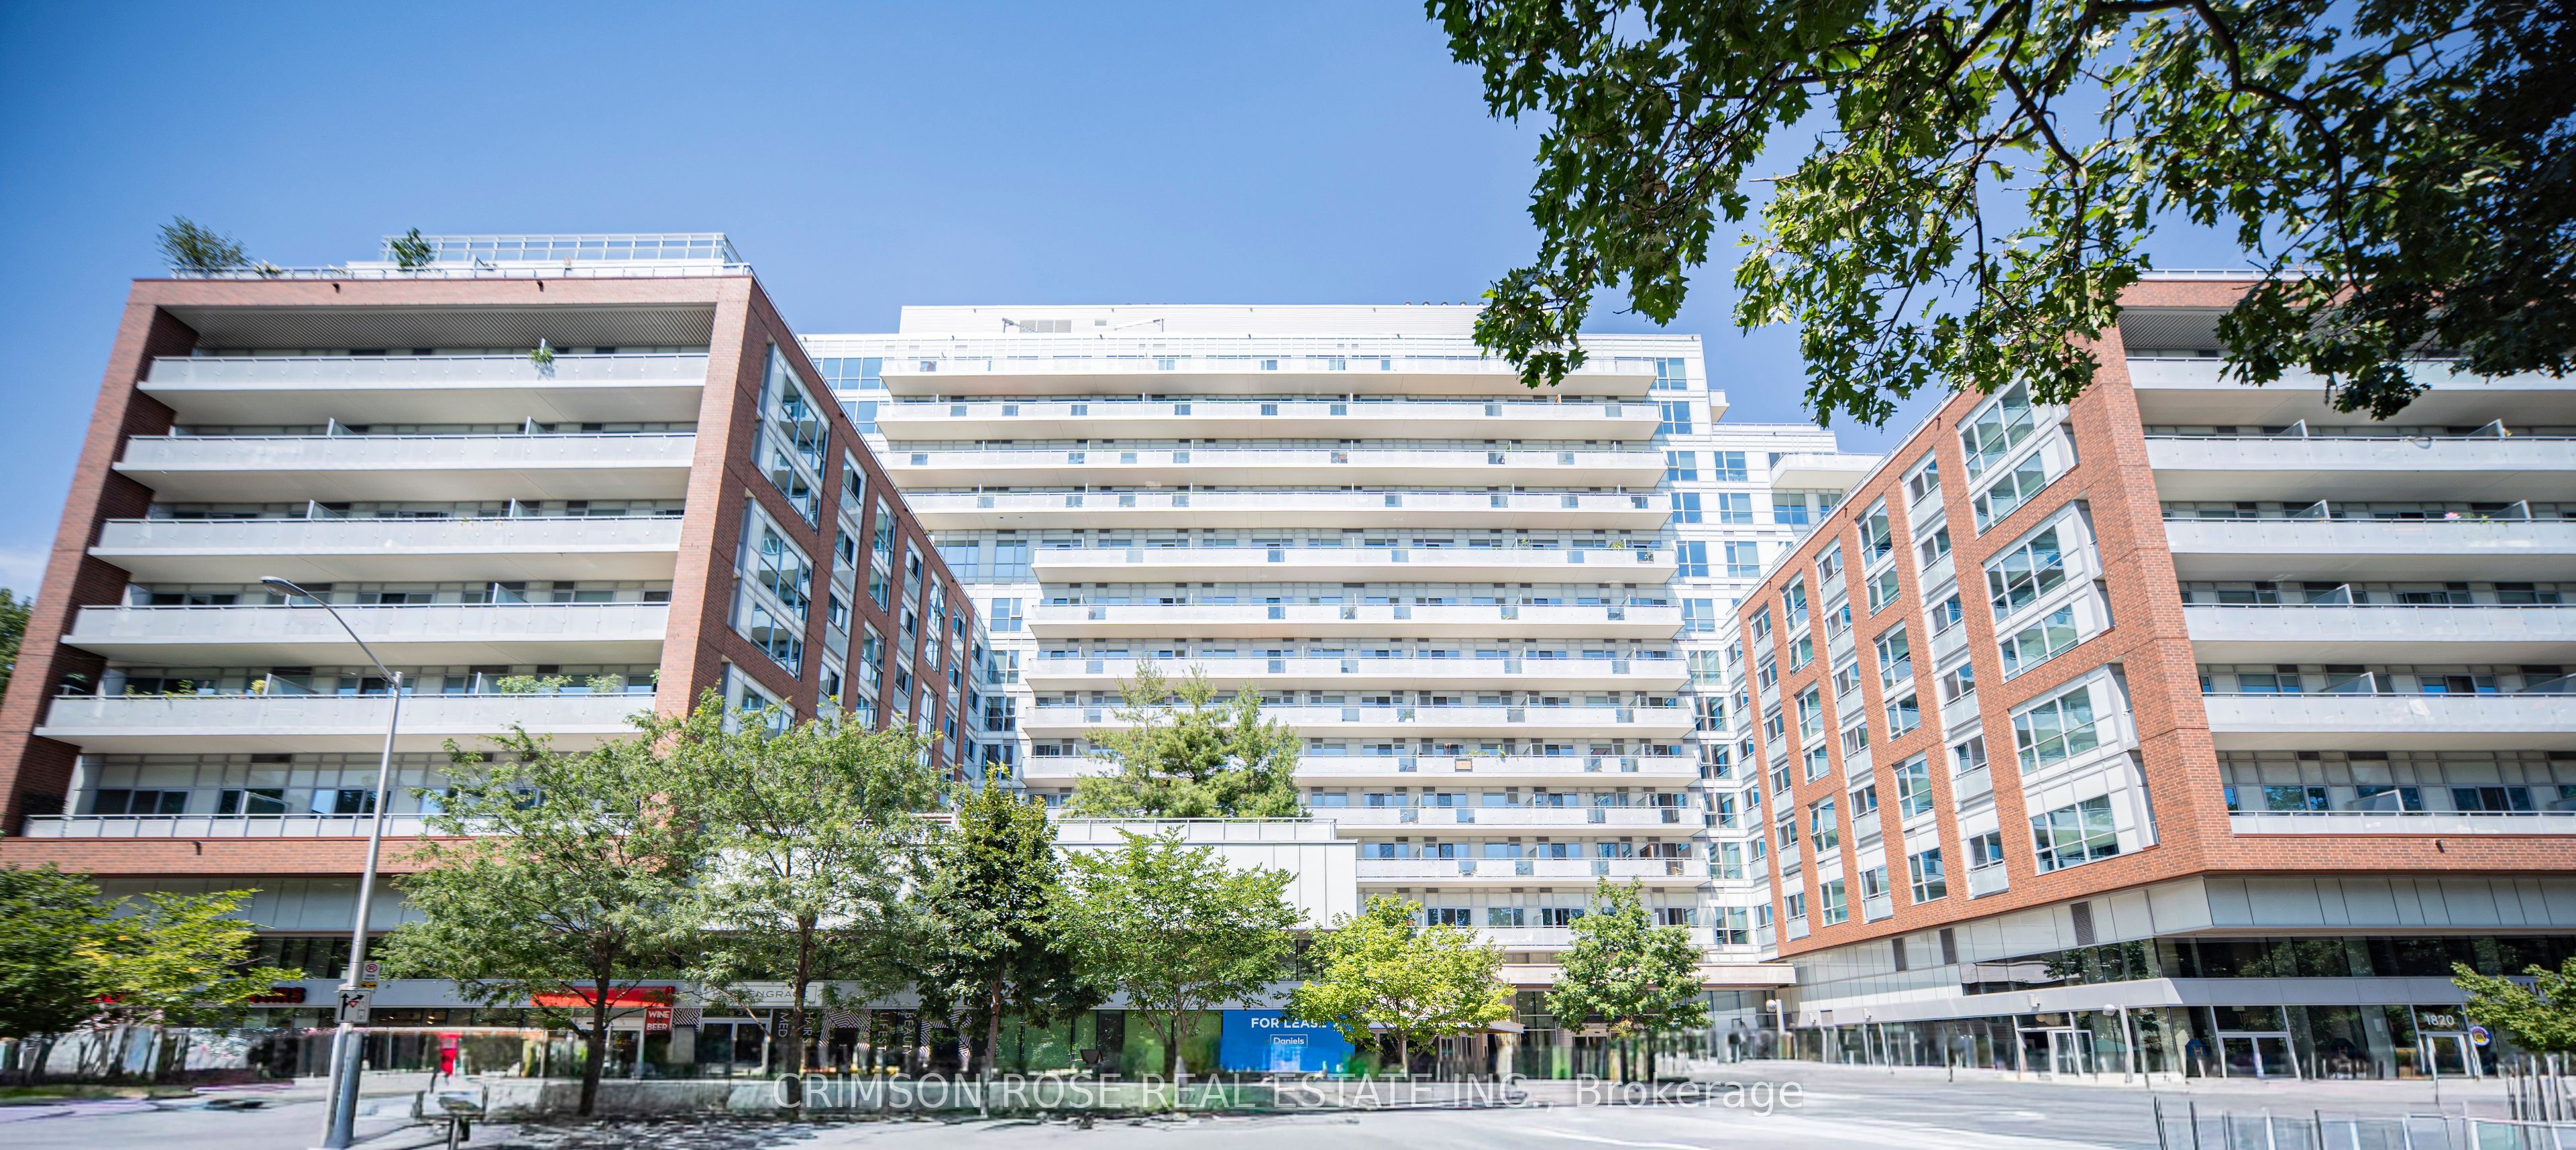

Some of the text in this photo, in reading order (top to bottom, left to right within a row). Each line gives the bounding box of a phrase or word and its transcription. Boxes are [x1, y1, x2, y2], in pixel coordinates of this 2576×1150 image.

[779, 1013, 789, 1037] MED
[1251, 1017, 1279, 1029] FOR
[2424, 1015, 2455, 1026] 1820
[902, 1013, 914, 1056] BEAUTY
[1273, 1037, 1305, 1045] Daniels
